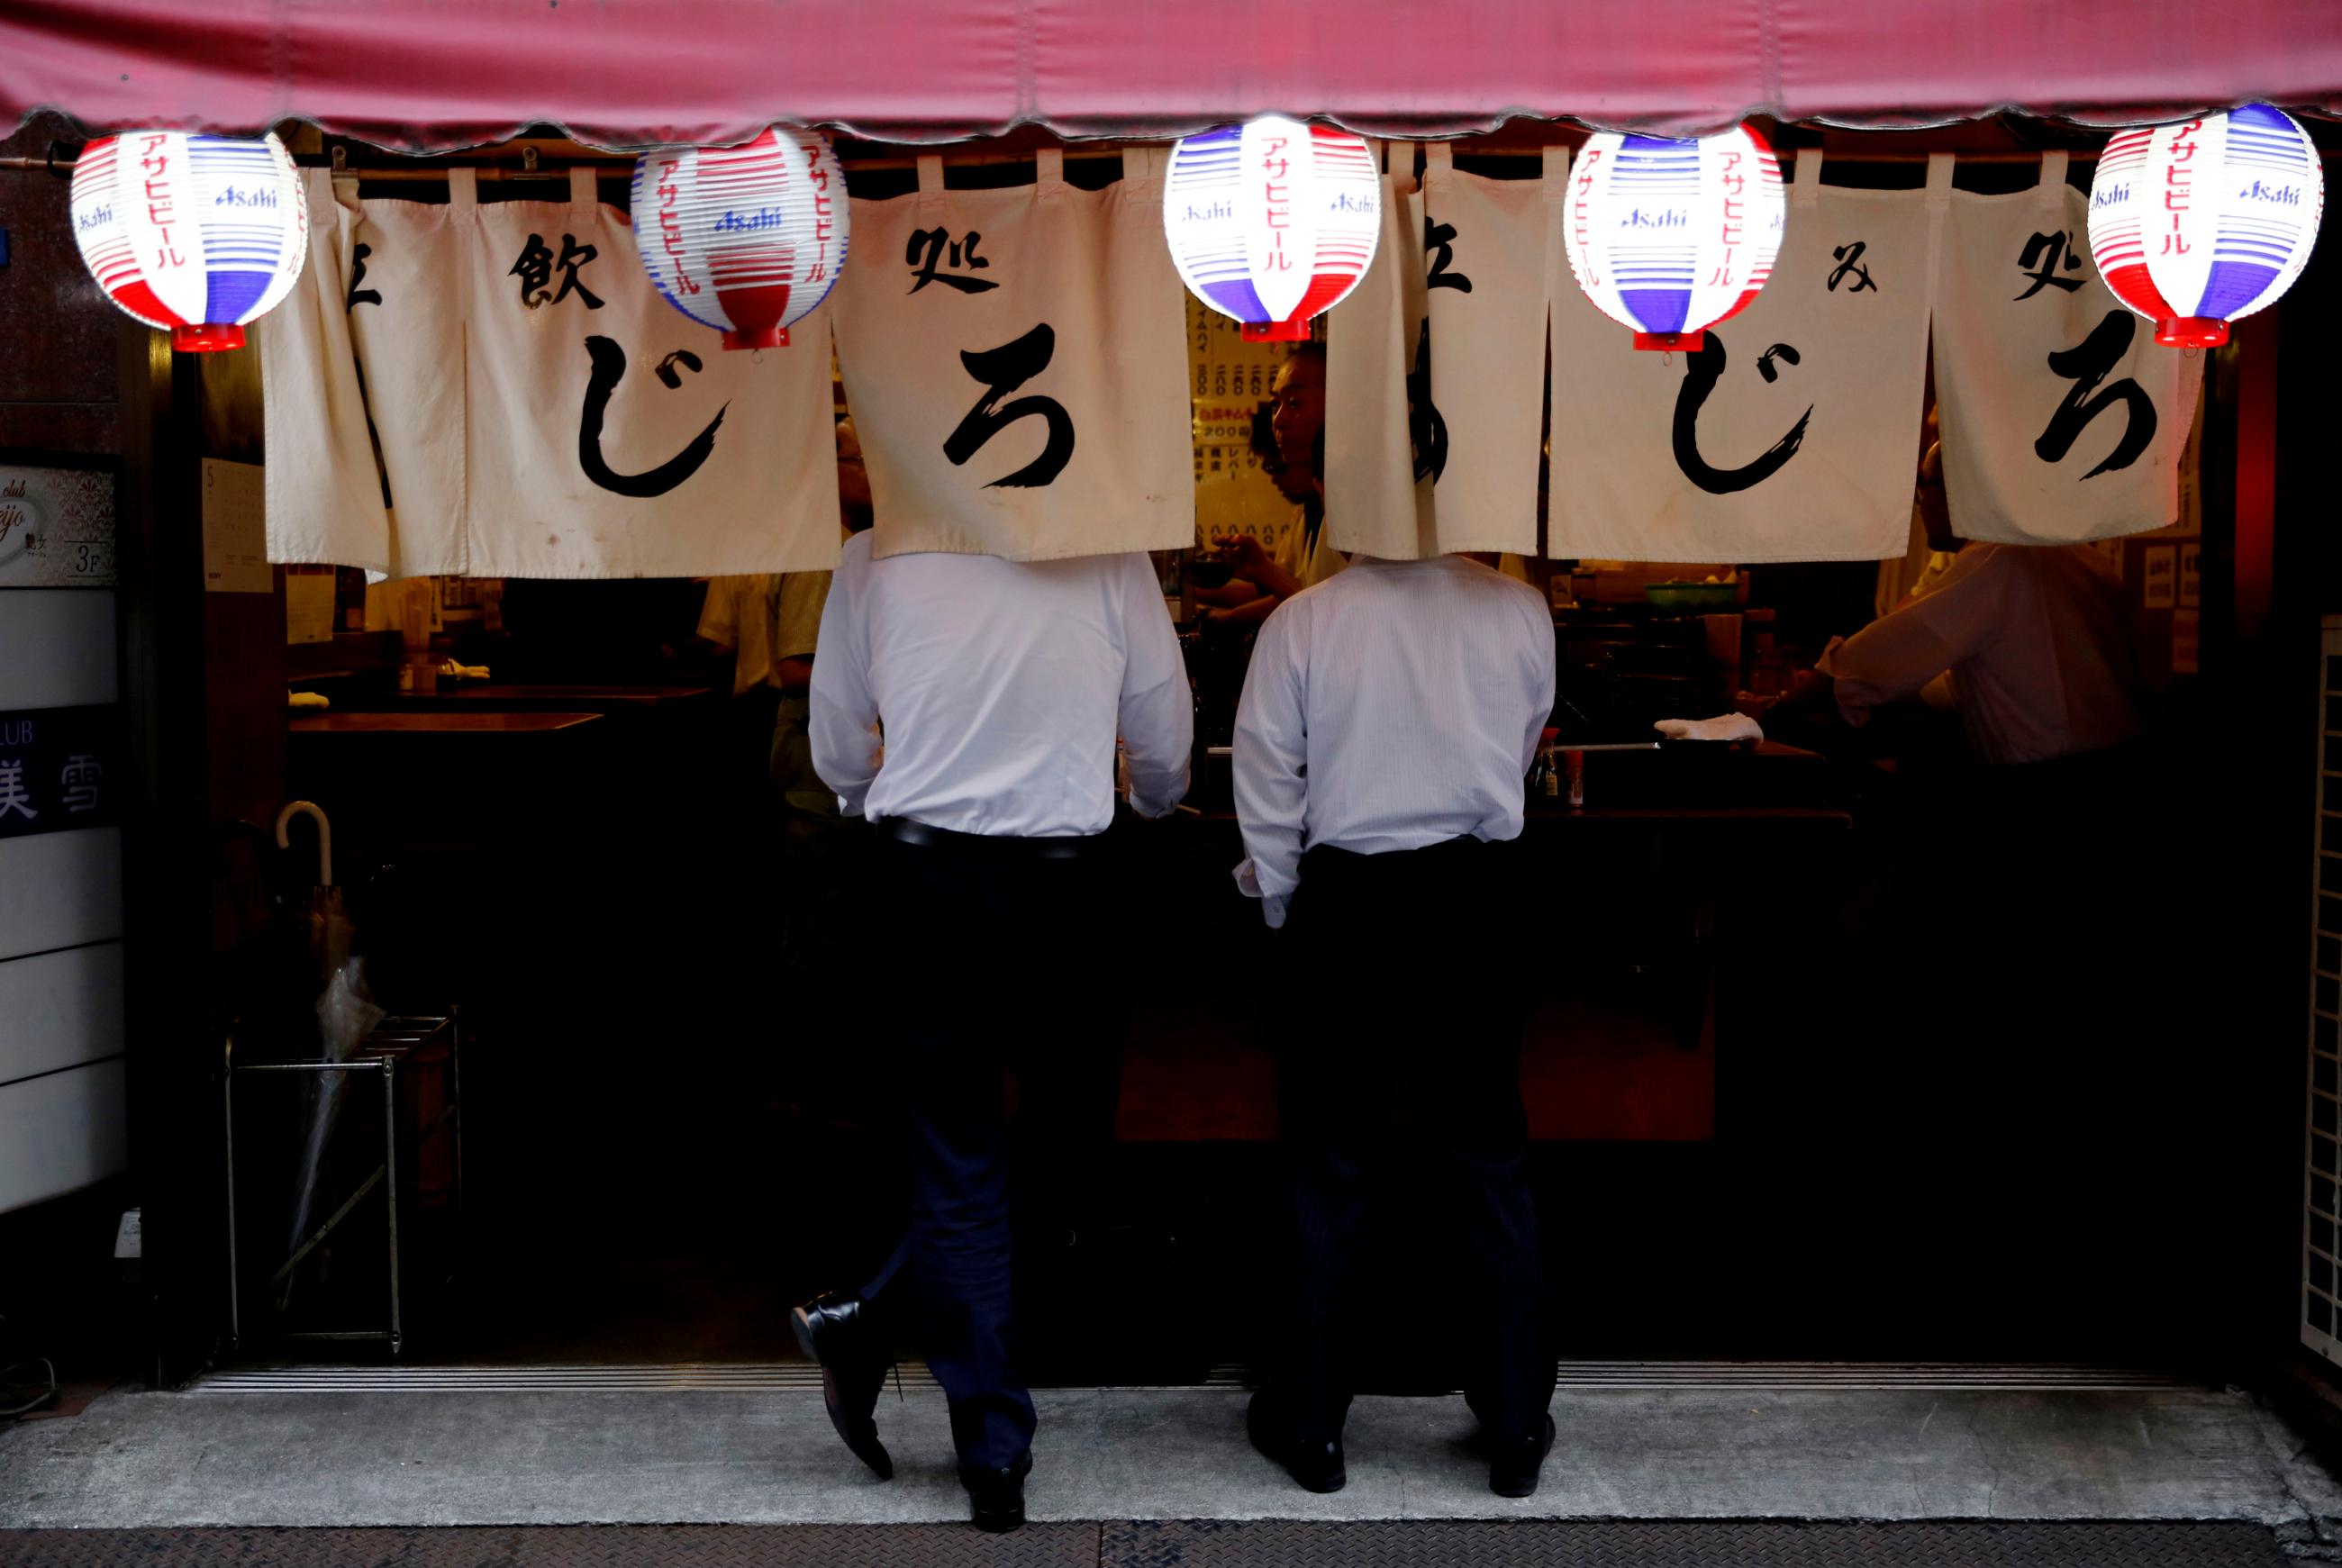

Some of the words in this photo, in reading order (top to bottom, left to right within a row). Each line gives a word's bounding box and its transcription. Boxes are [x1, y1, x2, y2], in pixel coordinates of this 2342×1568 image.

[140, 133, 186, 270] アサヒビール
[215, 184, 277, 209] Asahi
[656, 159, 701, 296] アサヒビール
[713, 205, 782, 232] Asahi
[800, 144, 833, 284] アサヒビール
[1181, 199, 1232, 222] Asahi
[1260, 137, 1293, 272] アサヒビール
[1330, 192, 1375, 213] Asahi
[1574, 150, 1602, 287] アサヒビール
[1620, 206, 1688, 229] Asahi
[1707, 151, 1745, 287] アサヒビール
[2159, 120, 2202, 257] アサヒビール
[2238, 179, 2301, 207] Asahi
[507, 232, 605, 310] 飲
[905, 226, 1000, 295] 処
[578, 334, 732, 497] じ
[943, 322, 1076, 489] ろ
[2034, 309, 2158, 483] ろ
[76, 545, 100, 573] 3F
[0, 720, 33, 746] UB
